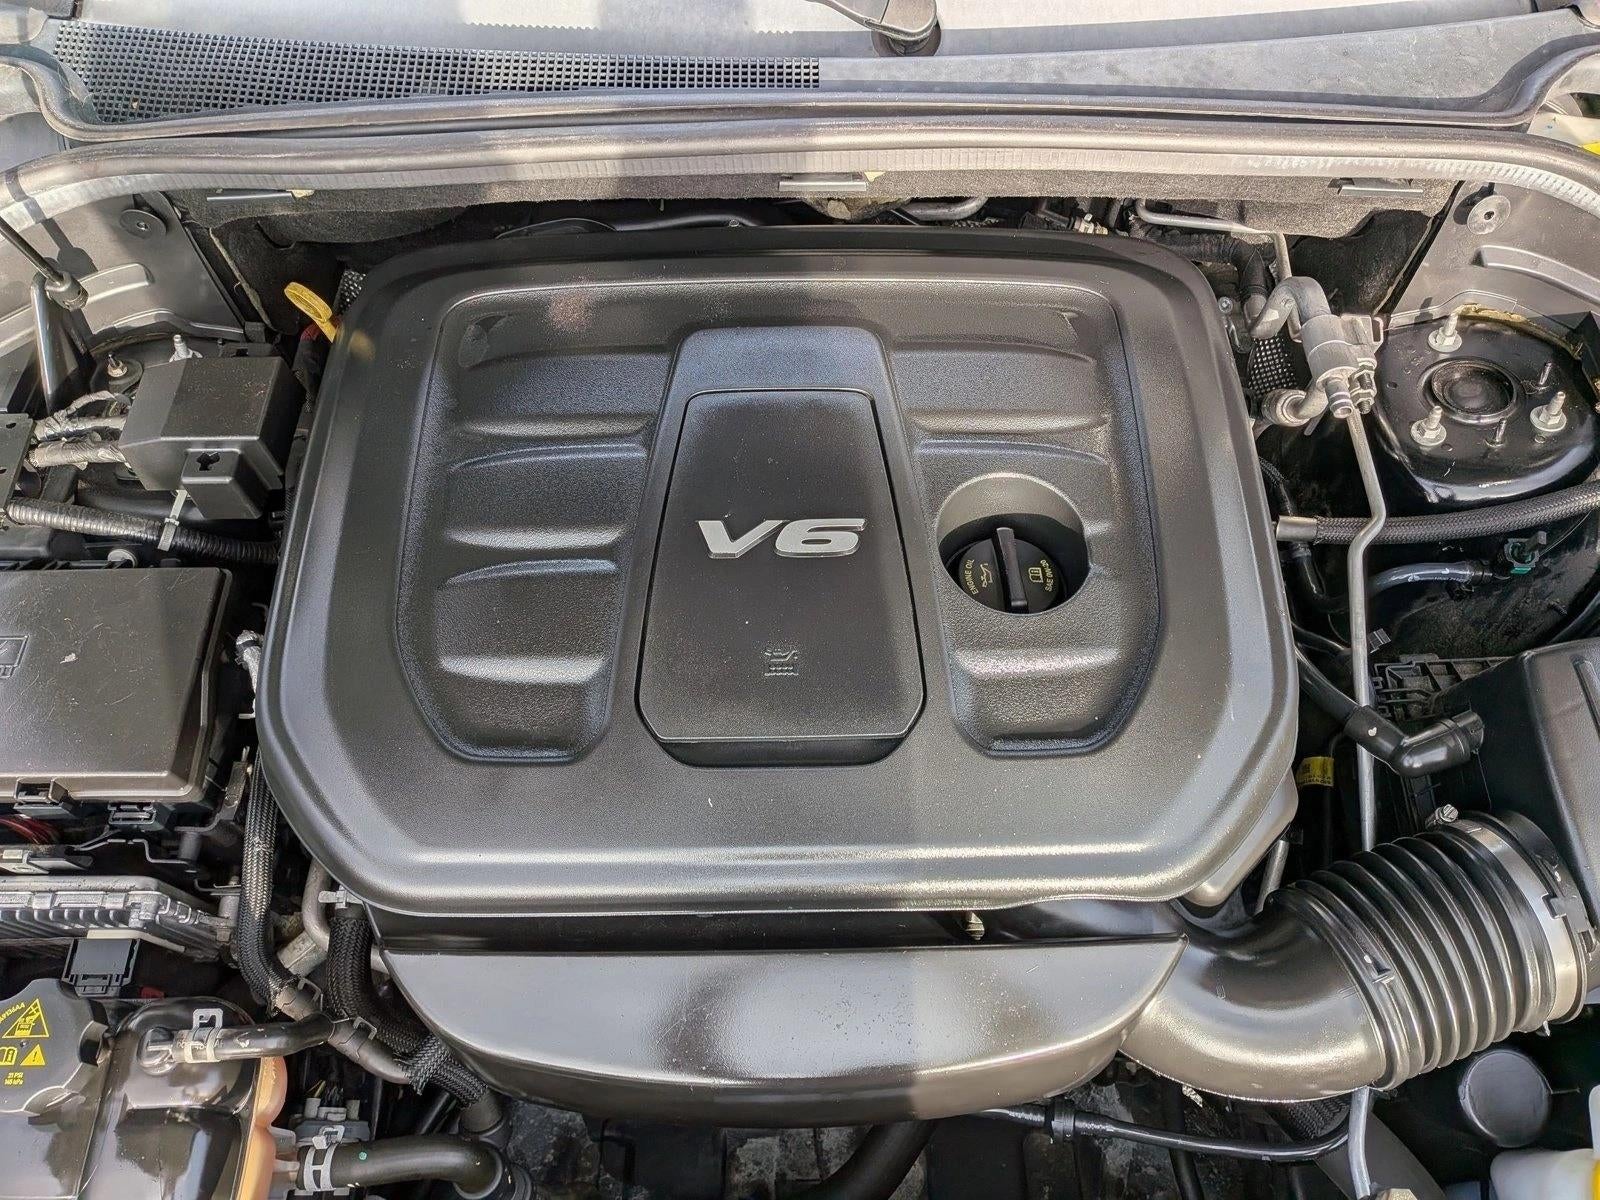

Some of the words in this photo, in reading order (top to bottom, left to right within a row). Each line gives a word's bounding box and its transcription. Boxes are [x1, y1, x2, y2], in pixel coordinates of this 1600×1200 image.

[695, 518, 866, 558] V6
[965, 559, 975, 569] OIL
[964, 570, 979, 595] ENGINE
